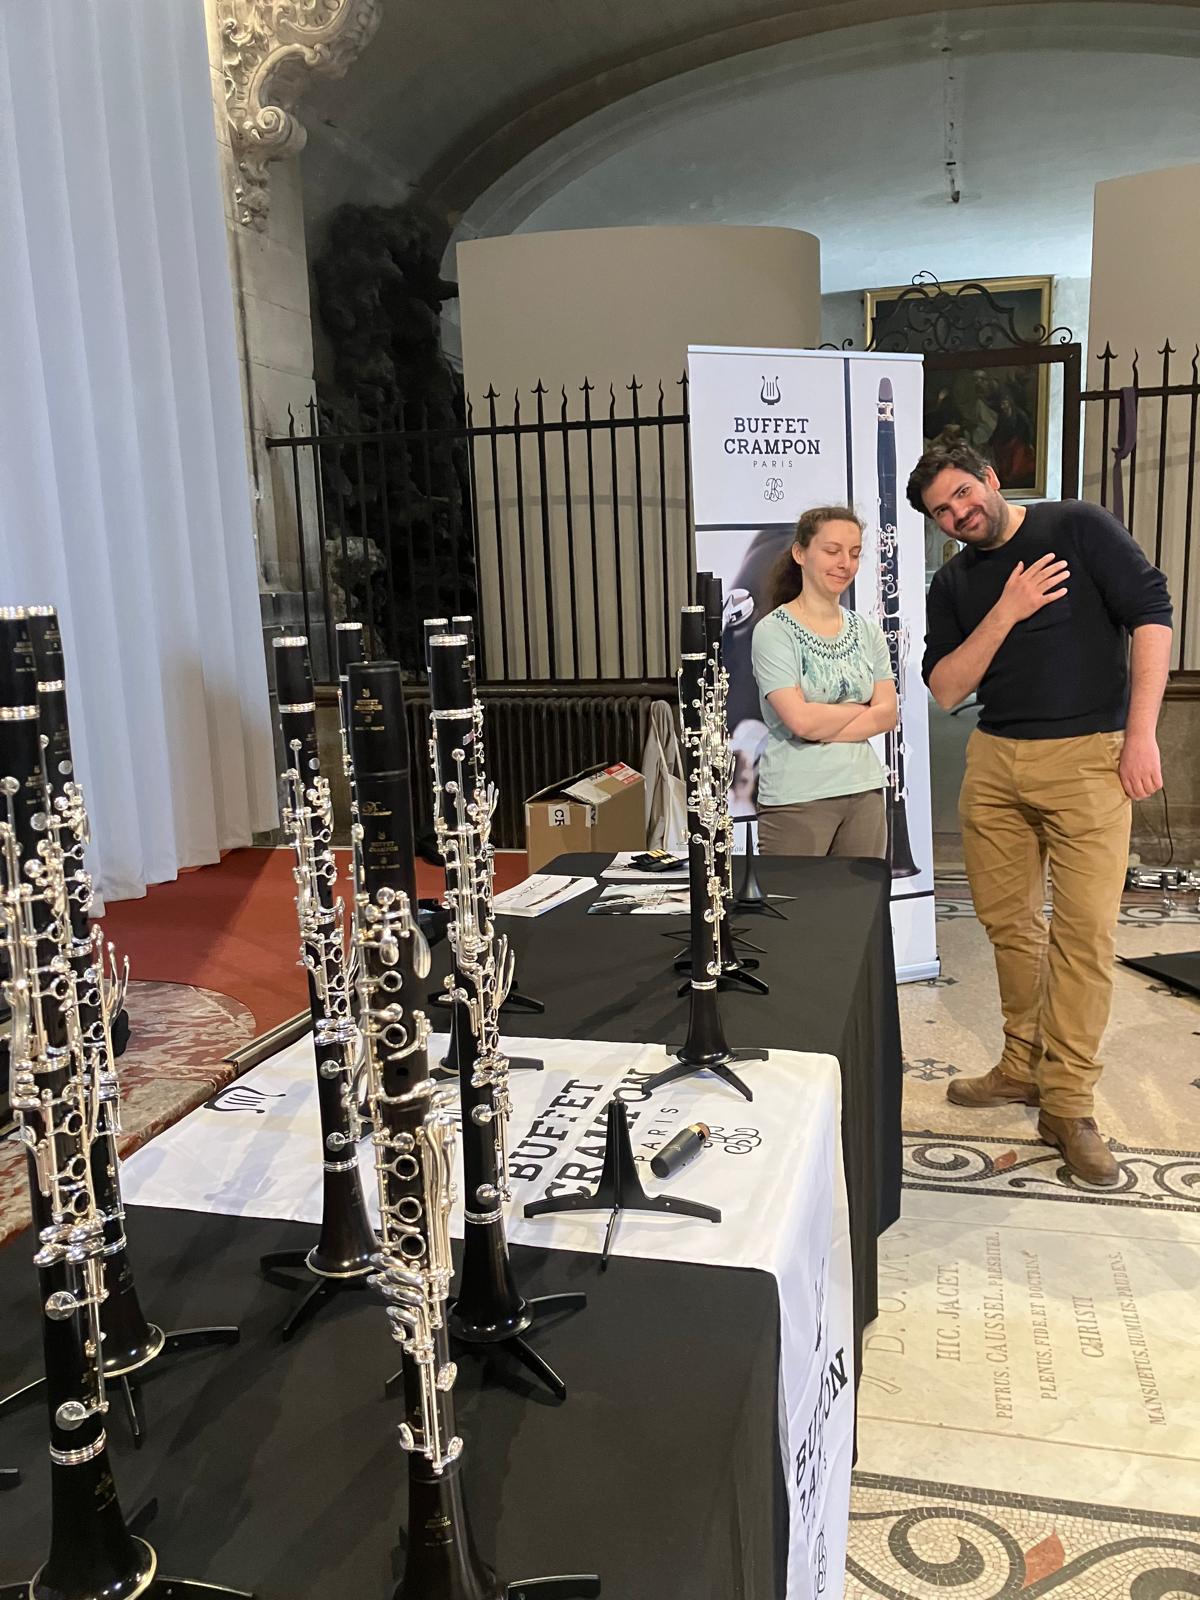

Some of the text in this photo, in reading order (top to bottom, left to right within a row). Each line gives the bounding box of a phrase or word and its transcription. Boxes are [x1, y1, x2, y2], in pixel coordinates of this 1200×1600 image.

[733, 416, 809, 434] BUFFET
[723, 438, 820, 455] CRAMPON
[752, 460, 794, 468] PARIS
[633, 1106, 680, 1163] PARIS
[1071, 1294, 1105, 1358] CHRISTI
